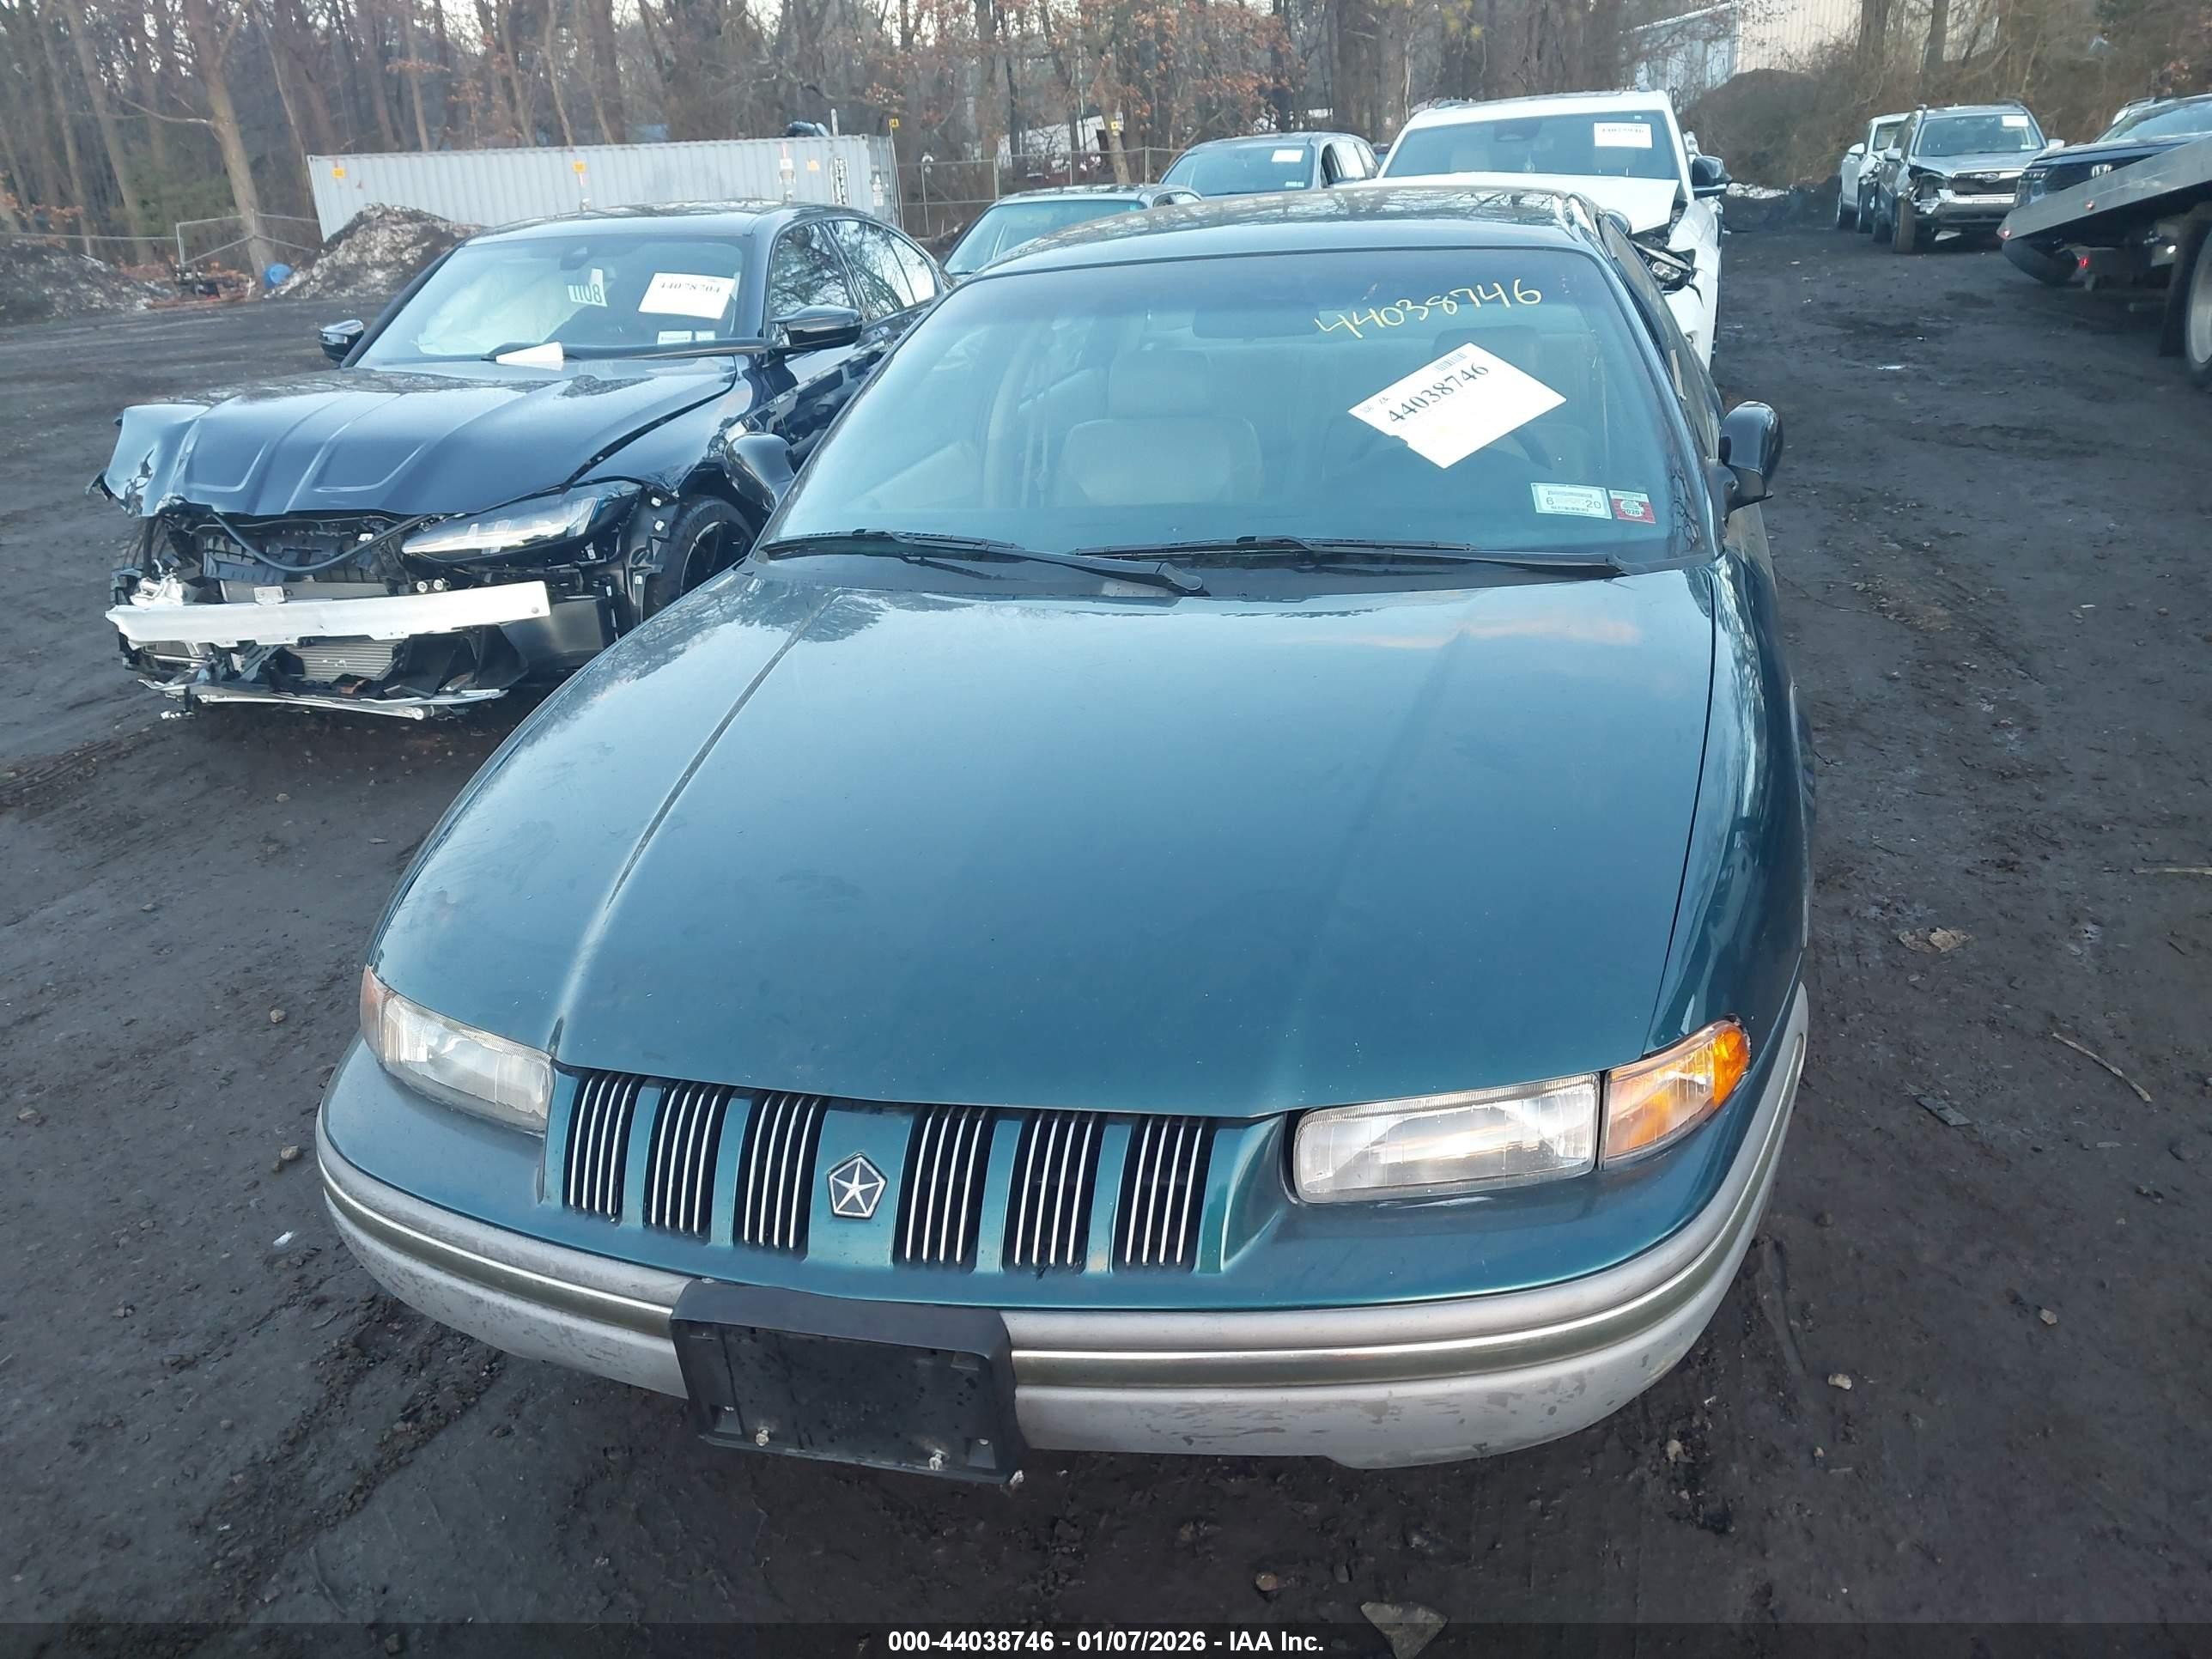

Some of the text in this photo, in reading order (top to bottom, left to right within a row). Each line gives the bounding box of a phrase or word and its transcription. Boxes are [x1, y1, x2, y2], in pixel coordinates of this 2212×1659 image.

[1314, 278, 1542, 339] 44038746
[1388, 362, 1490, 422] 44038746
[1585, 500, 1601, 509] 20
